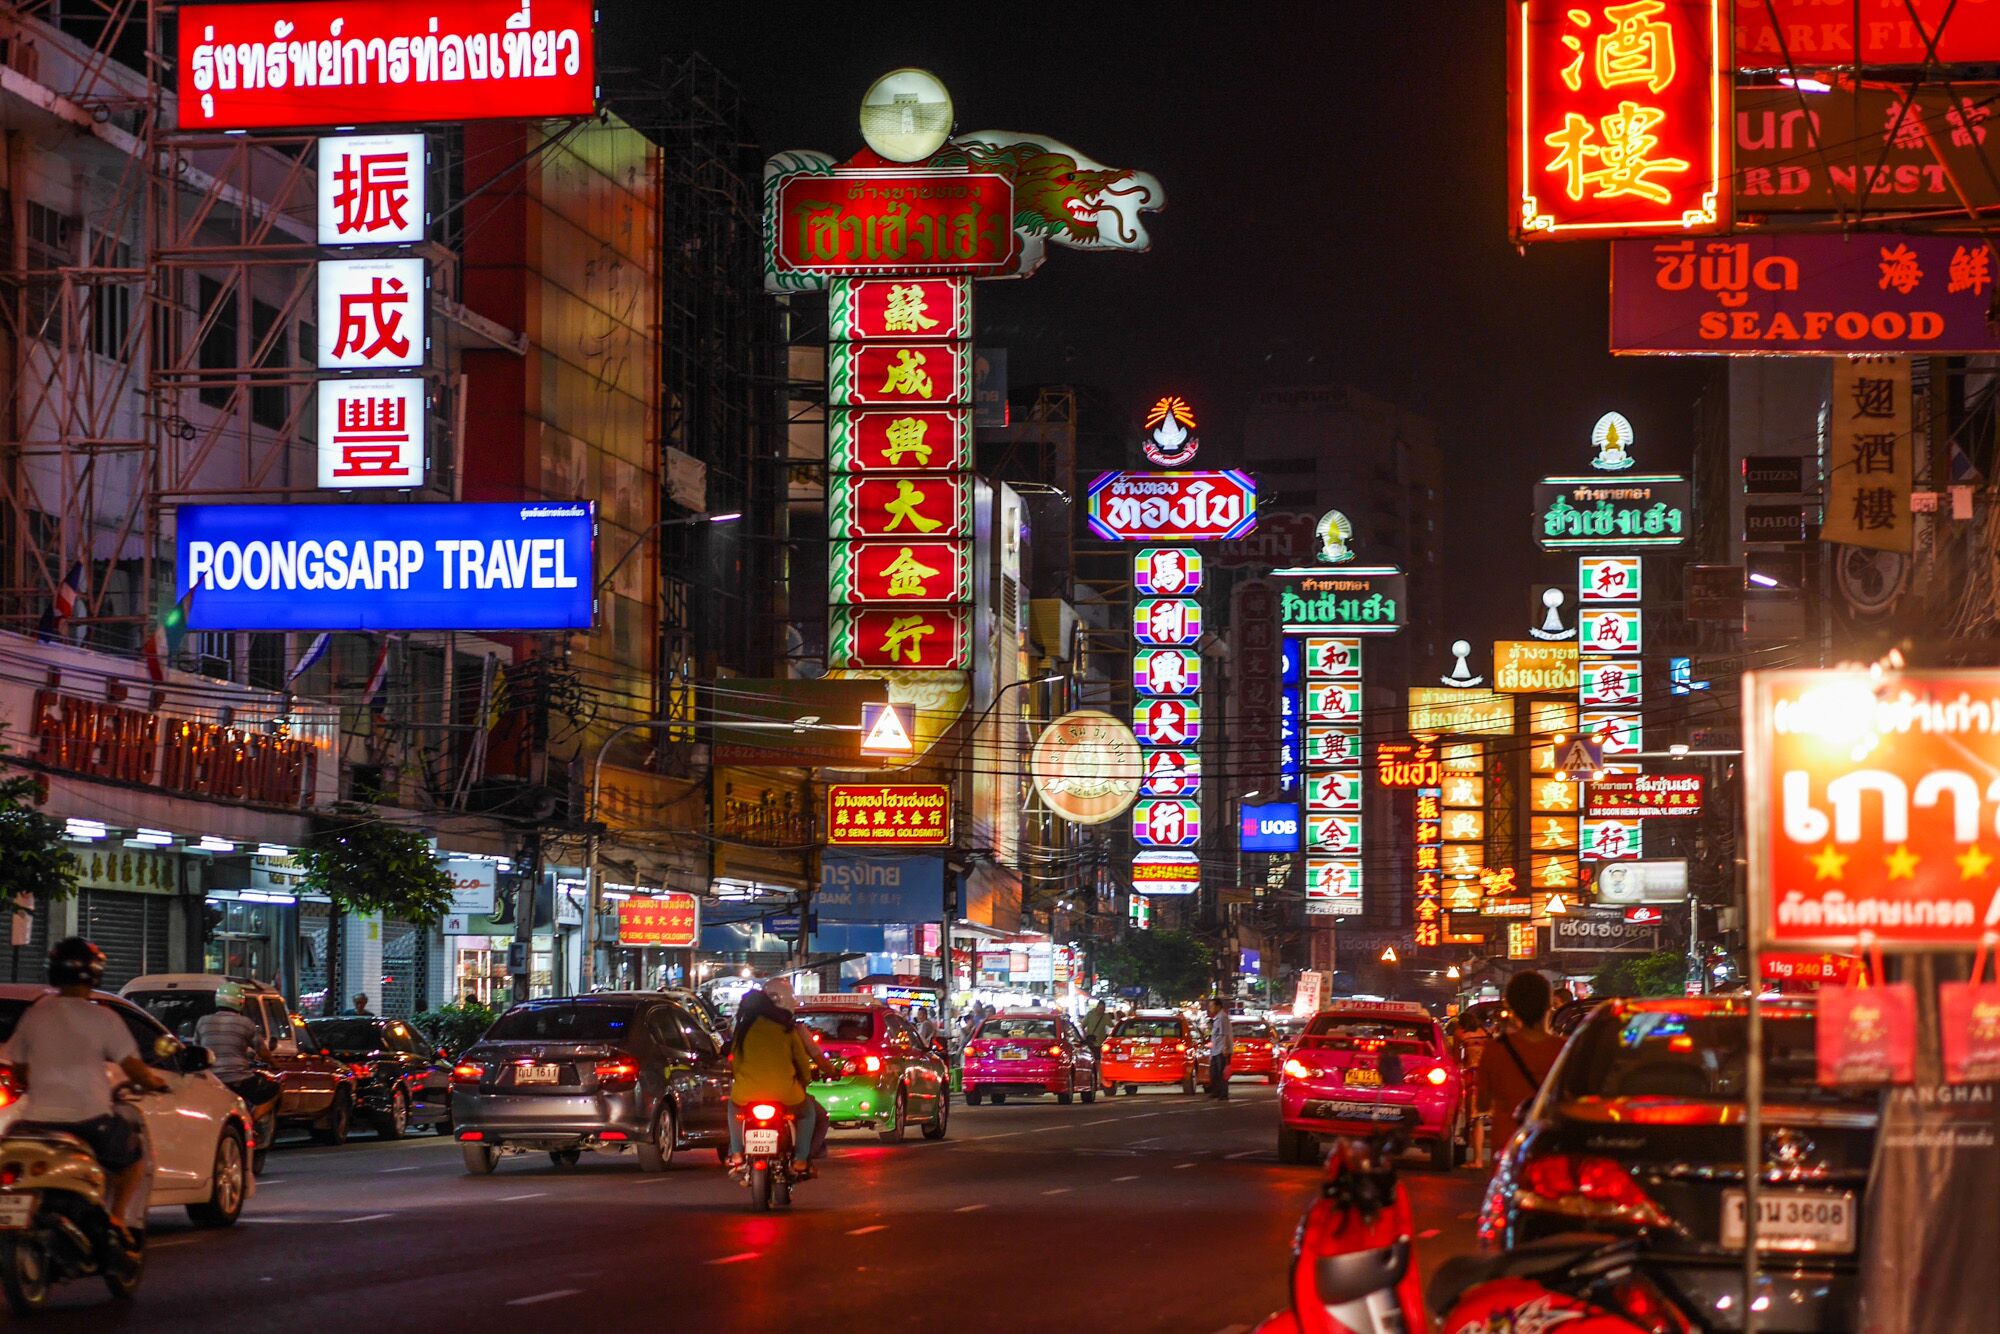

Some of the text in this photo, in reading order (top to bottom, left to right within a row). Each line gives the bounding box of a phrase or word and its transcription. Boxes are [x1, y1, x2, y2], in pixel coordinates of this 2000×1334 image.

[192, 0, 580, 118] รุ่งทรัพย์การท่องเที่ยว
[1545, 0, 1689, 204] 酒樓
[1736, 165, 1947, 195] RD NEST
[1878, 243, 1991, 296] 海鮮
[332, 152, 410, 477] 振成豐
[1699, 311, 1944, 340] SEAFOOD
[1851, 357, 1897, 531] 翅酒樓
[879, 284, 943, 663] 蘇成興大金行
[1750, 470, 1799, 481] CITIZEN
[1750, 516, 1799, 528] RADO
[189, 538, 578, 591] ROONGSARP TRAVEL
[1596, 567, 1626, 855] 和成興大行
[1319, 645, 1349, 893] 和成興大金行
[1590, 807, 1602, 816] LIM
[1602, 807, 1619, 816] SOON
[1619, 807, 1638, 816] HENG
[834, 828, 944, 837] SO SENG HENG GOLDSMITH
[1261, 820, 1297, 834] UOB
[1134, 864, 1199, 879] EXCHANGE
[818, 892, 852, 904] BANK
[1769, 961, 1792, 976] 1kg
[1795, 962, 1819, 975] 240
[536, 1068, 557, 1077] 1611
[1787, 1202, 1843, 1224] 3608
